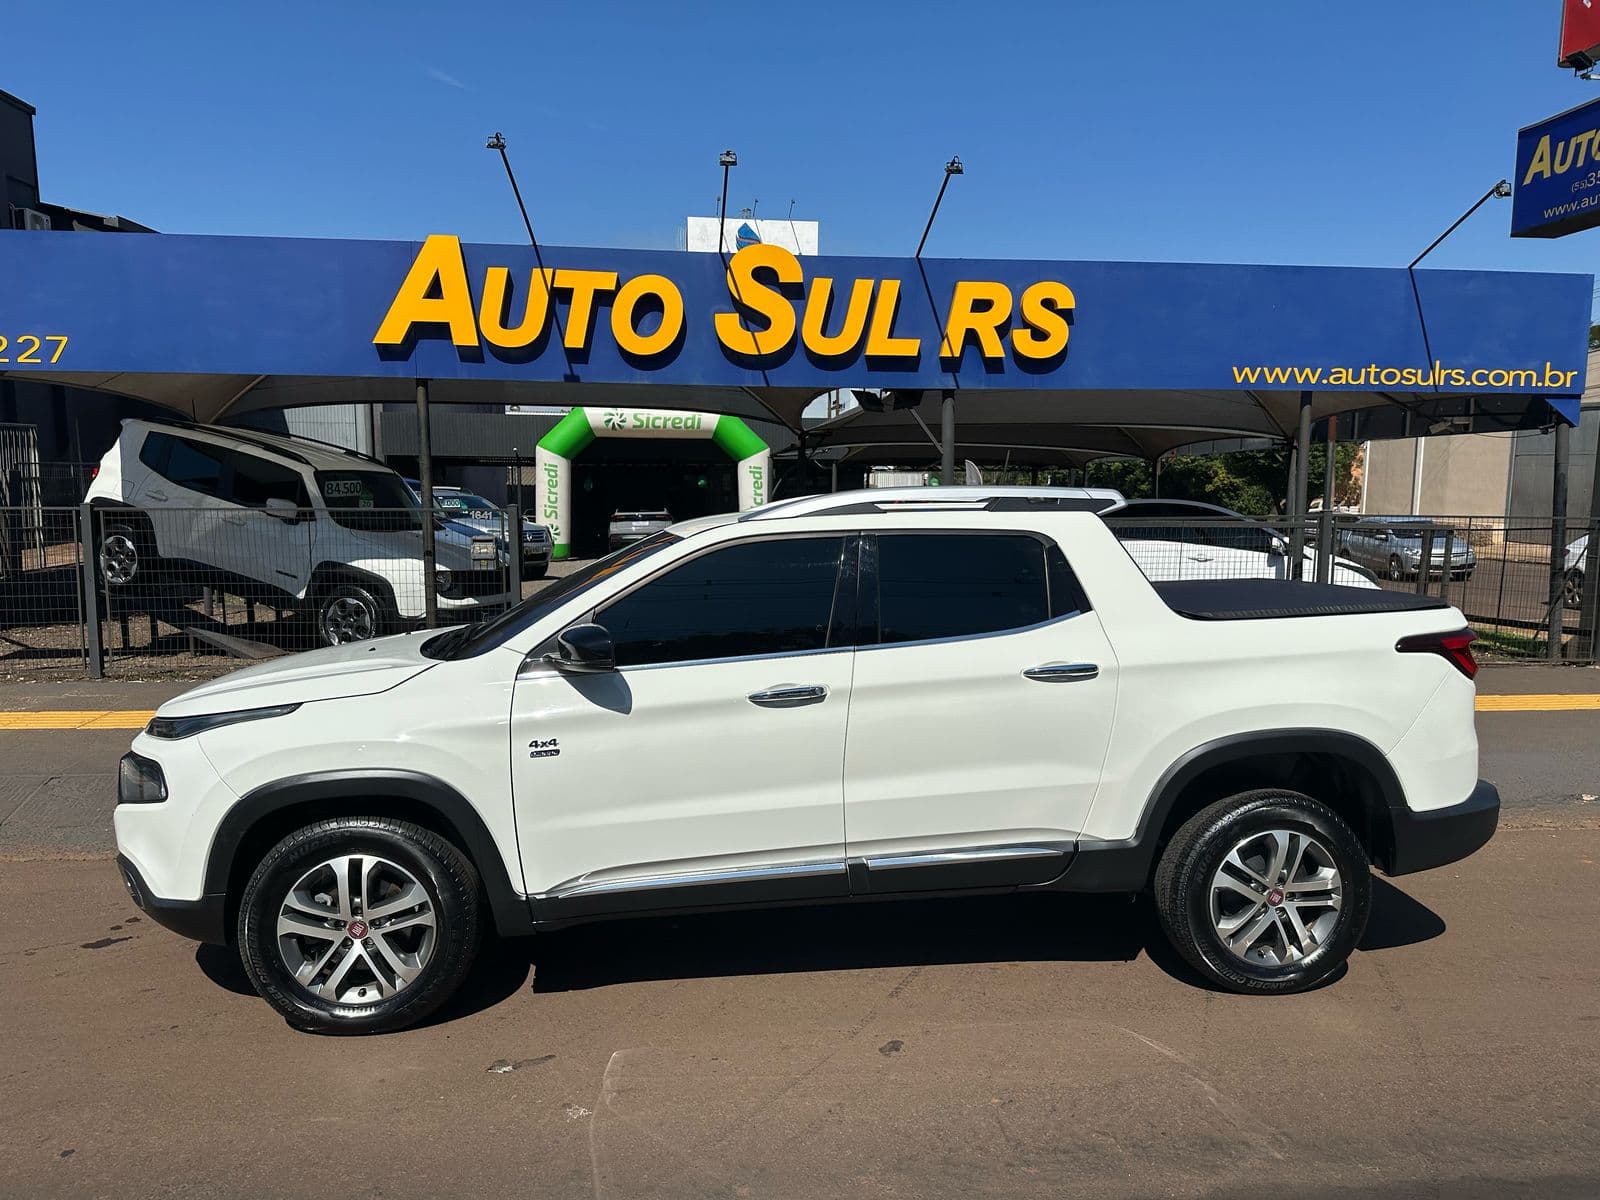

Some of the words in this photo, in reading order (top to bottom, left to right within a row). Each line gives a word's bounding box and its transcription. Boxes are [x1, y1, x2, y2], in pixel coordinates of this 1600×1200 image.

[1543, 194, 1600, 219] www.au
[372, 234, 684, 356] AUTO
[714, 243, 922, 356] SUL
[939, 280, 1076, 359] RS
[1232, 360, 1578, 389] www.autosulrs.com.br
[632, 412, 702, 430] Sicredi
[543, 462, 559, 520] Sicredi
[748, 465, 764, 508] credi
[470, 510, 492, 520] 1641
[529, 738, 559, 748] 4x4
